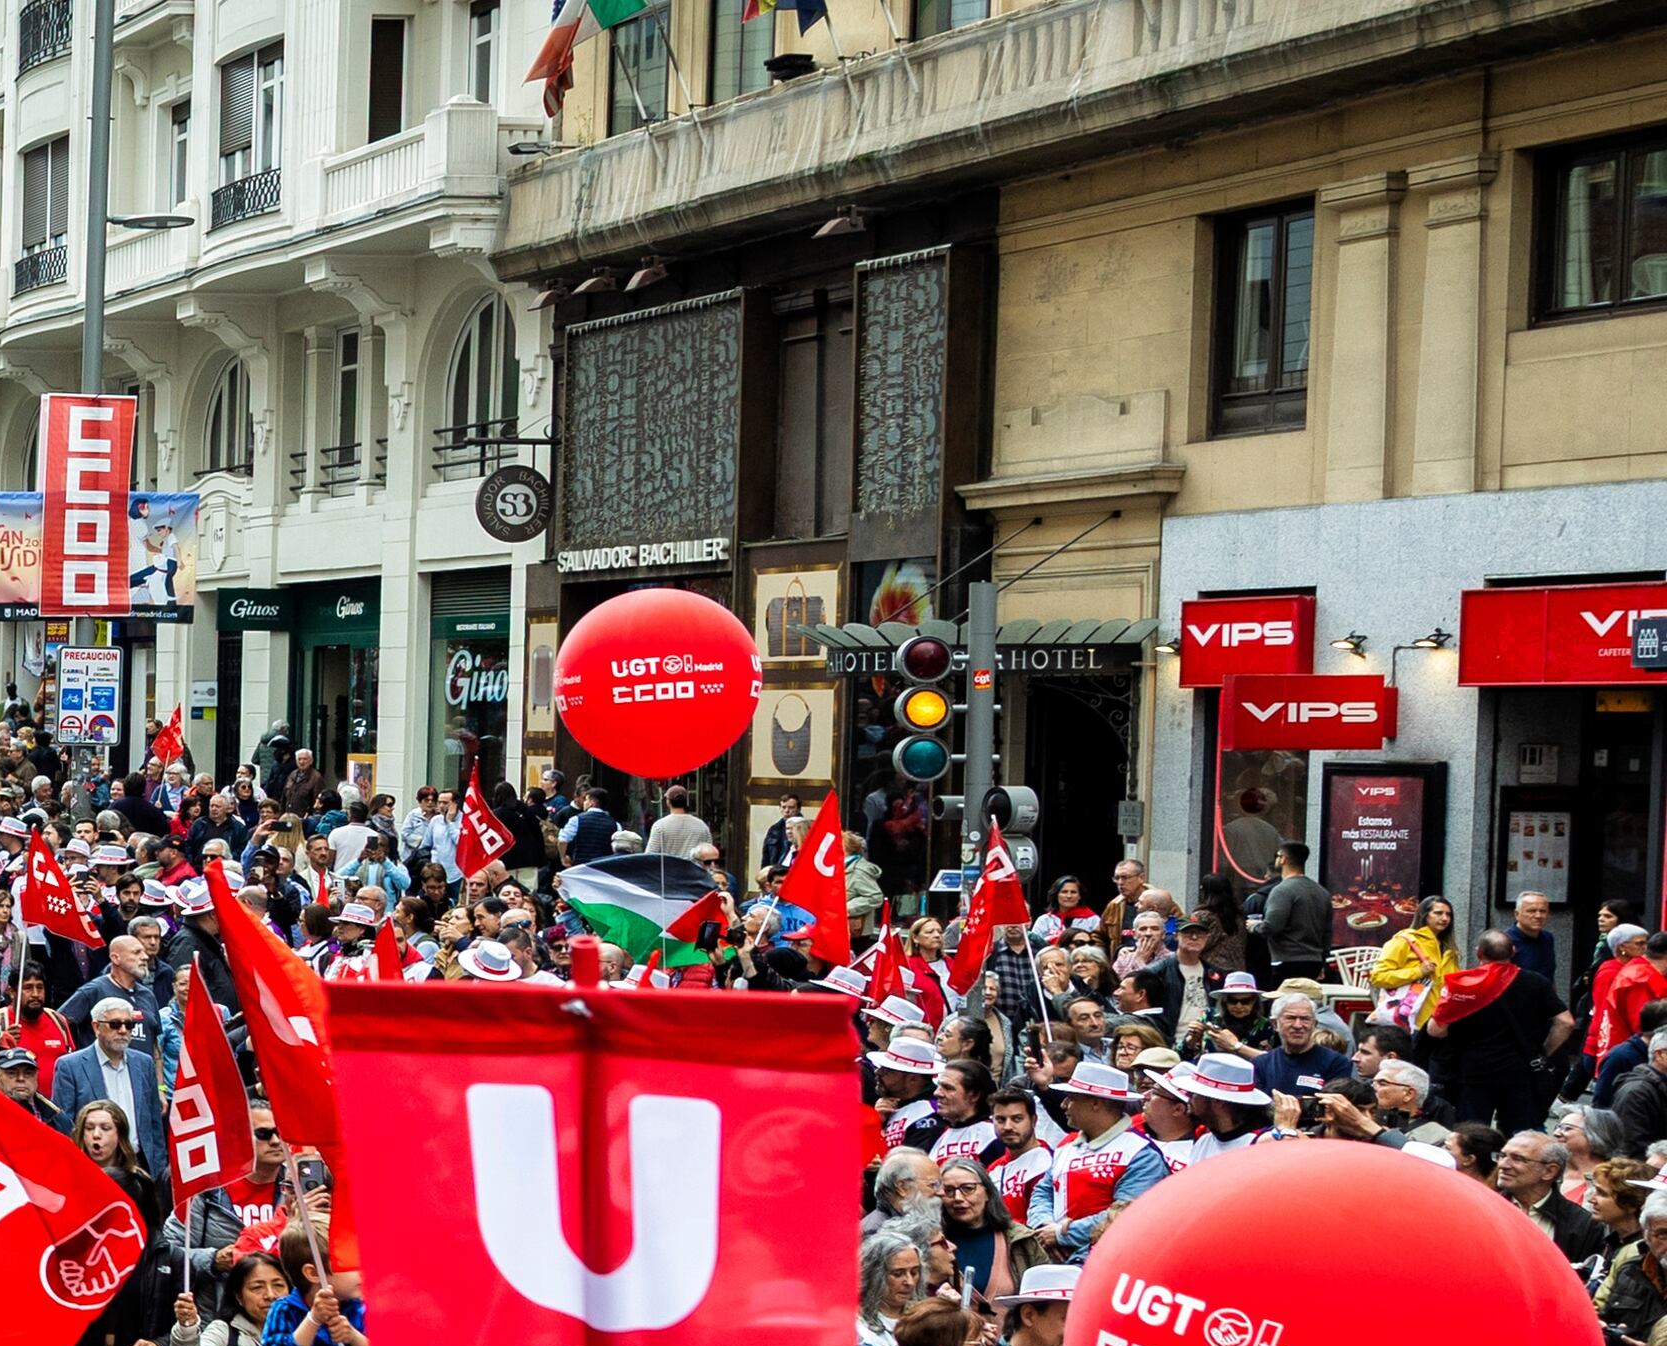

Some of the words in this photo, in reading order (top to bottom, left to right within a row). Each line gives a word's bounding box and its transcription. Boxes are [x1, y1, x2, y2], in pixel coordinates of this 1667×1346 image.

[63, 406, 113, 605] CCOO
[483, 476, 511, 535] SALVADOR
[519, 471, 549, 534] BACHILLER
[1, 546, 38, 571] ISID
[557, 545, 637, 573] SALVADOR
[639, 537, 728, 567] BACHILLER
[16, 608, 38, 617] MAD
[229, 599, 280, 619] Ginos
[336, 596, 364, 619] Ginos
[1187, 621, 1295, 647] VIPS
[64, 651, 118, 661] PRECAUCIÓN
[1011, 648, 1102, 671] HOTEL
[1598, 648, 1632, 657] CAFETER
[611, 657, 660, 678] UGT
[694, 662, 723, 672] Madrid
[445, 649, 509, 709] Gino
[974, 673, 990, 685] cgt
[612, 681, 695, 704] CCOO
[1242, 702, 1378, 723] VIPS
[1358, 787, 1395, 796] VIPS
[1359, 817, 1392, 827] Estamos
[1359, 829, 1410, 840] RESTAURANTE
[1352, 842, 1369, 852] que
[1370, 841, 1397, 851] nunca
[1111, 1273, 1206, 1336] UGT
